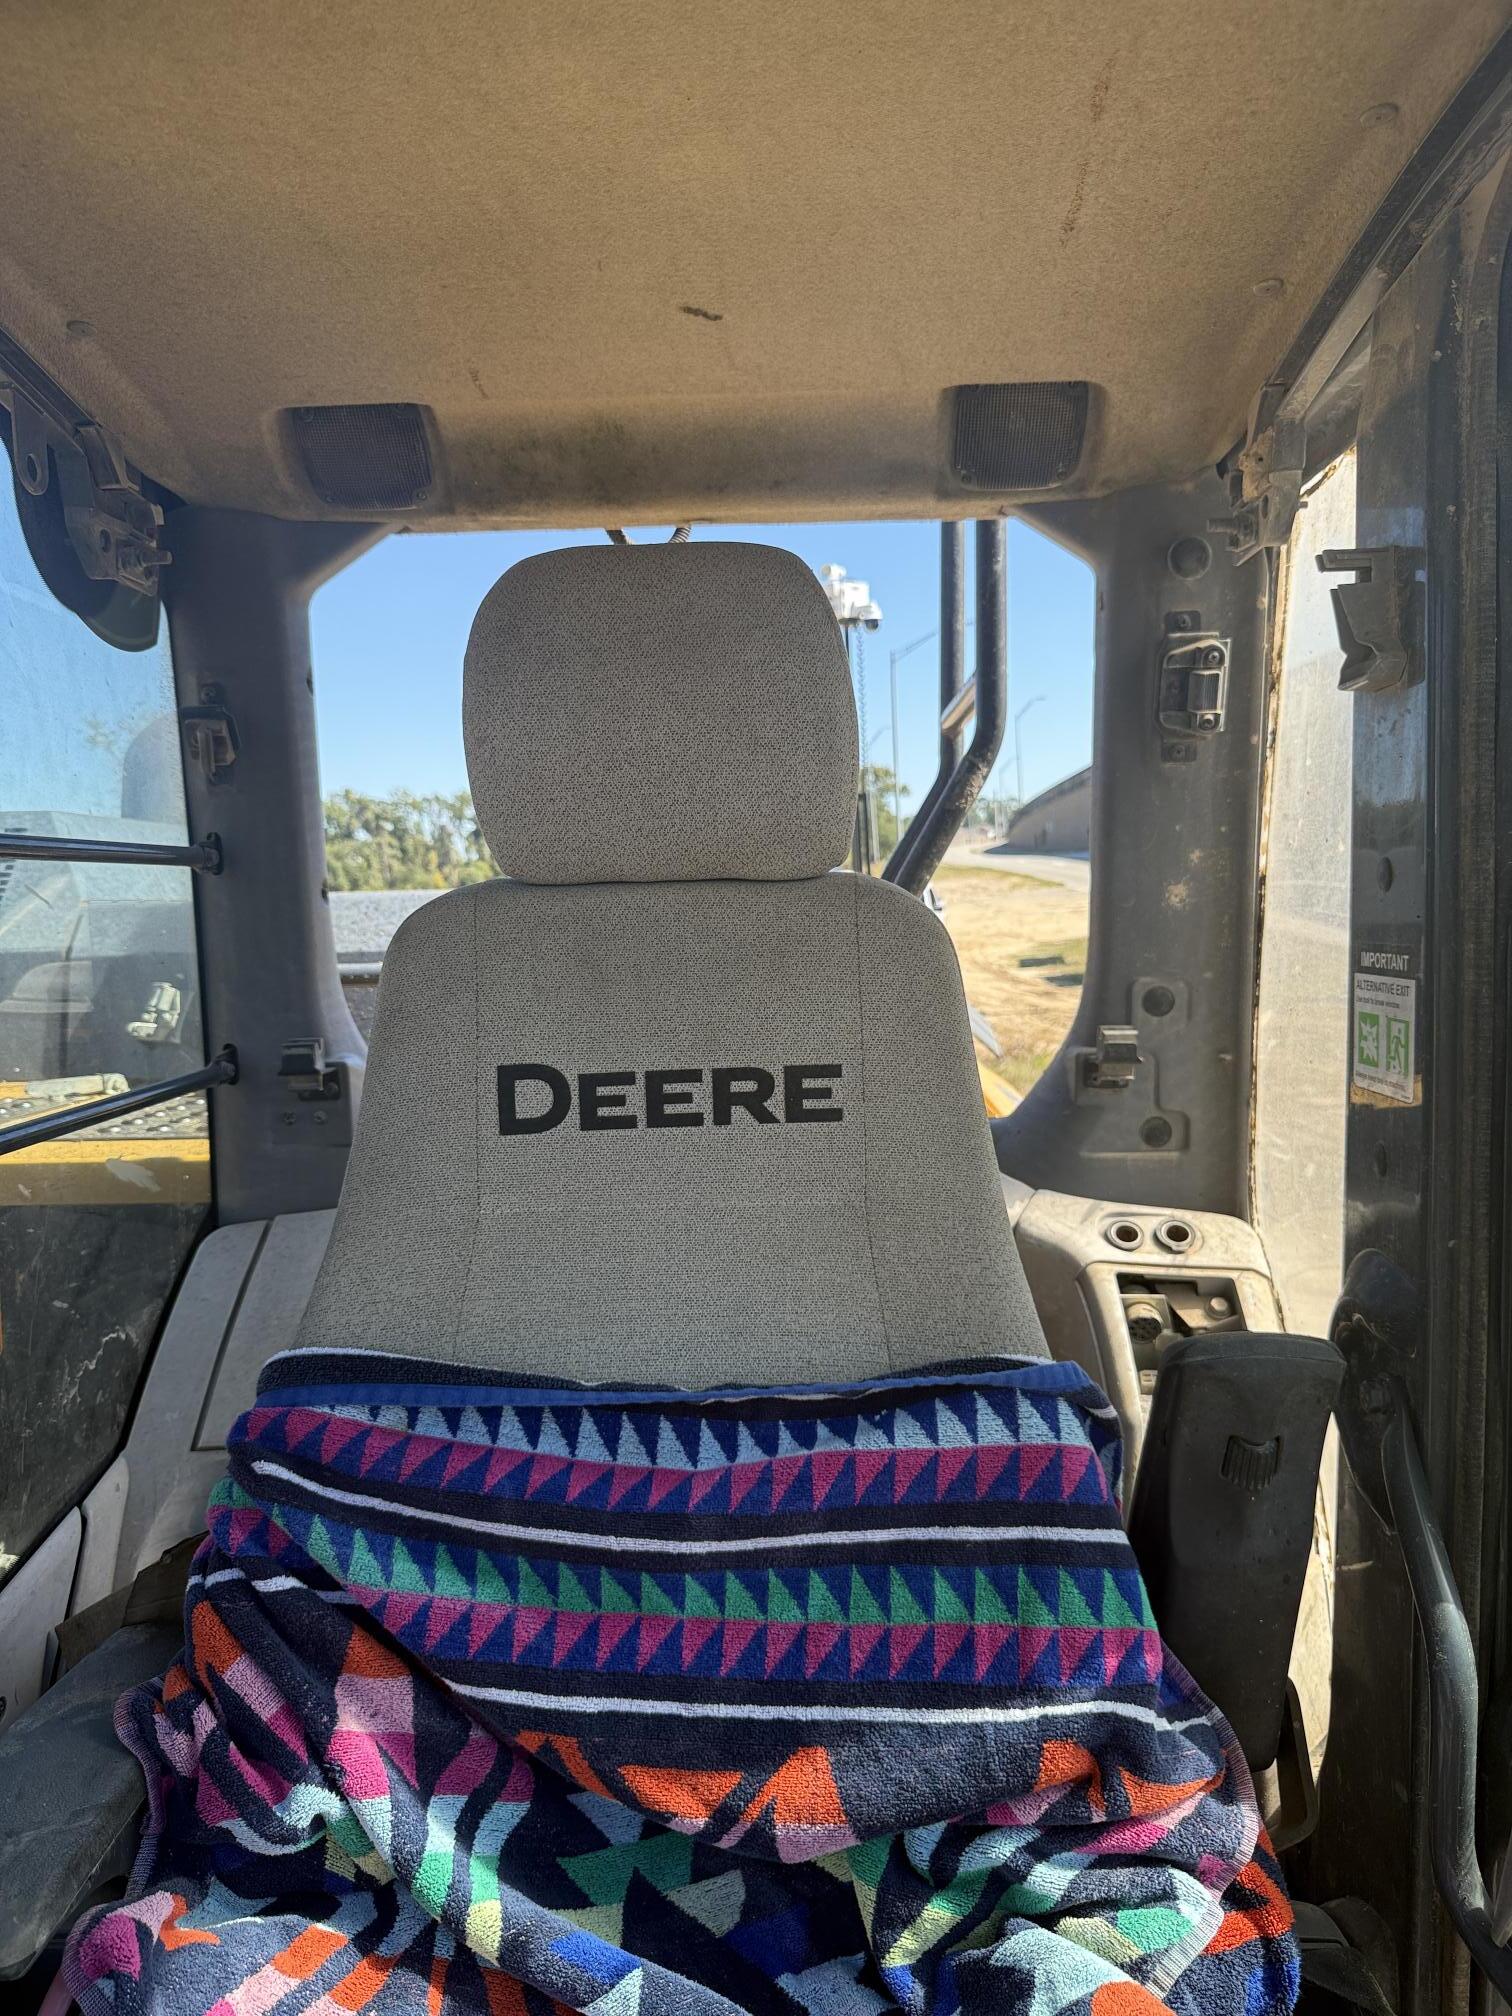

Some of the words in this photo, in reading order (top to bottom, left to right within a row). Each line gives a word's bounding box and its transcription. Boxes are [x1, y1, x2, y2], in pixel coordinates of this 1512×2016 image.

[1360, 951, 1409, 971] IMPORTANT
[1356, 979, 1395, 996] ALTERNATIVE
[1396, 984, 1410, 997] EXIT
[497, 1063, 843, 1136] DEERE
